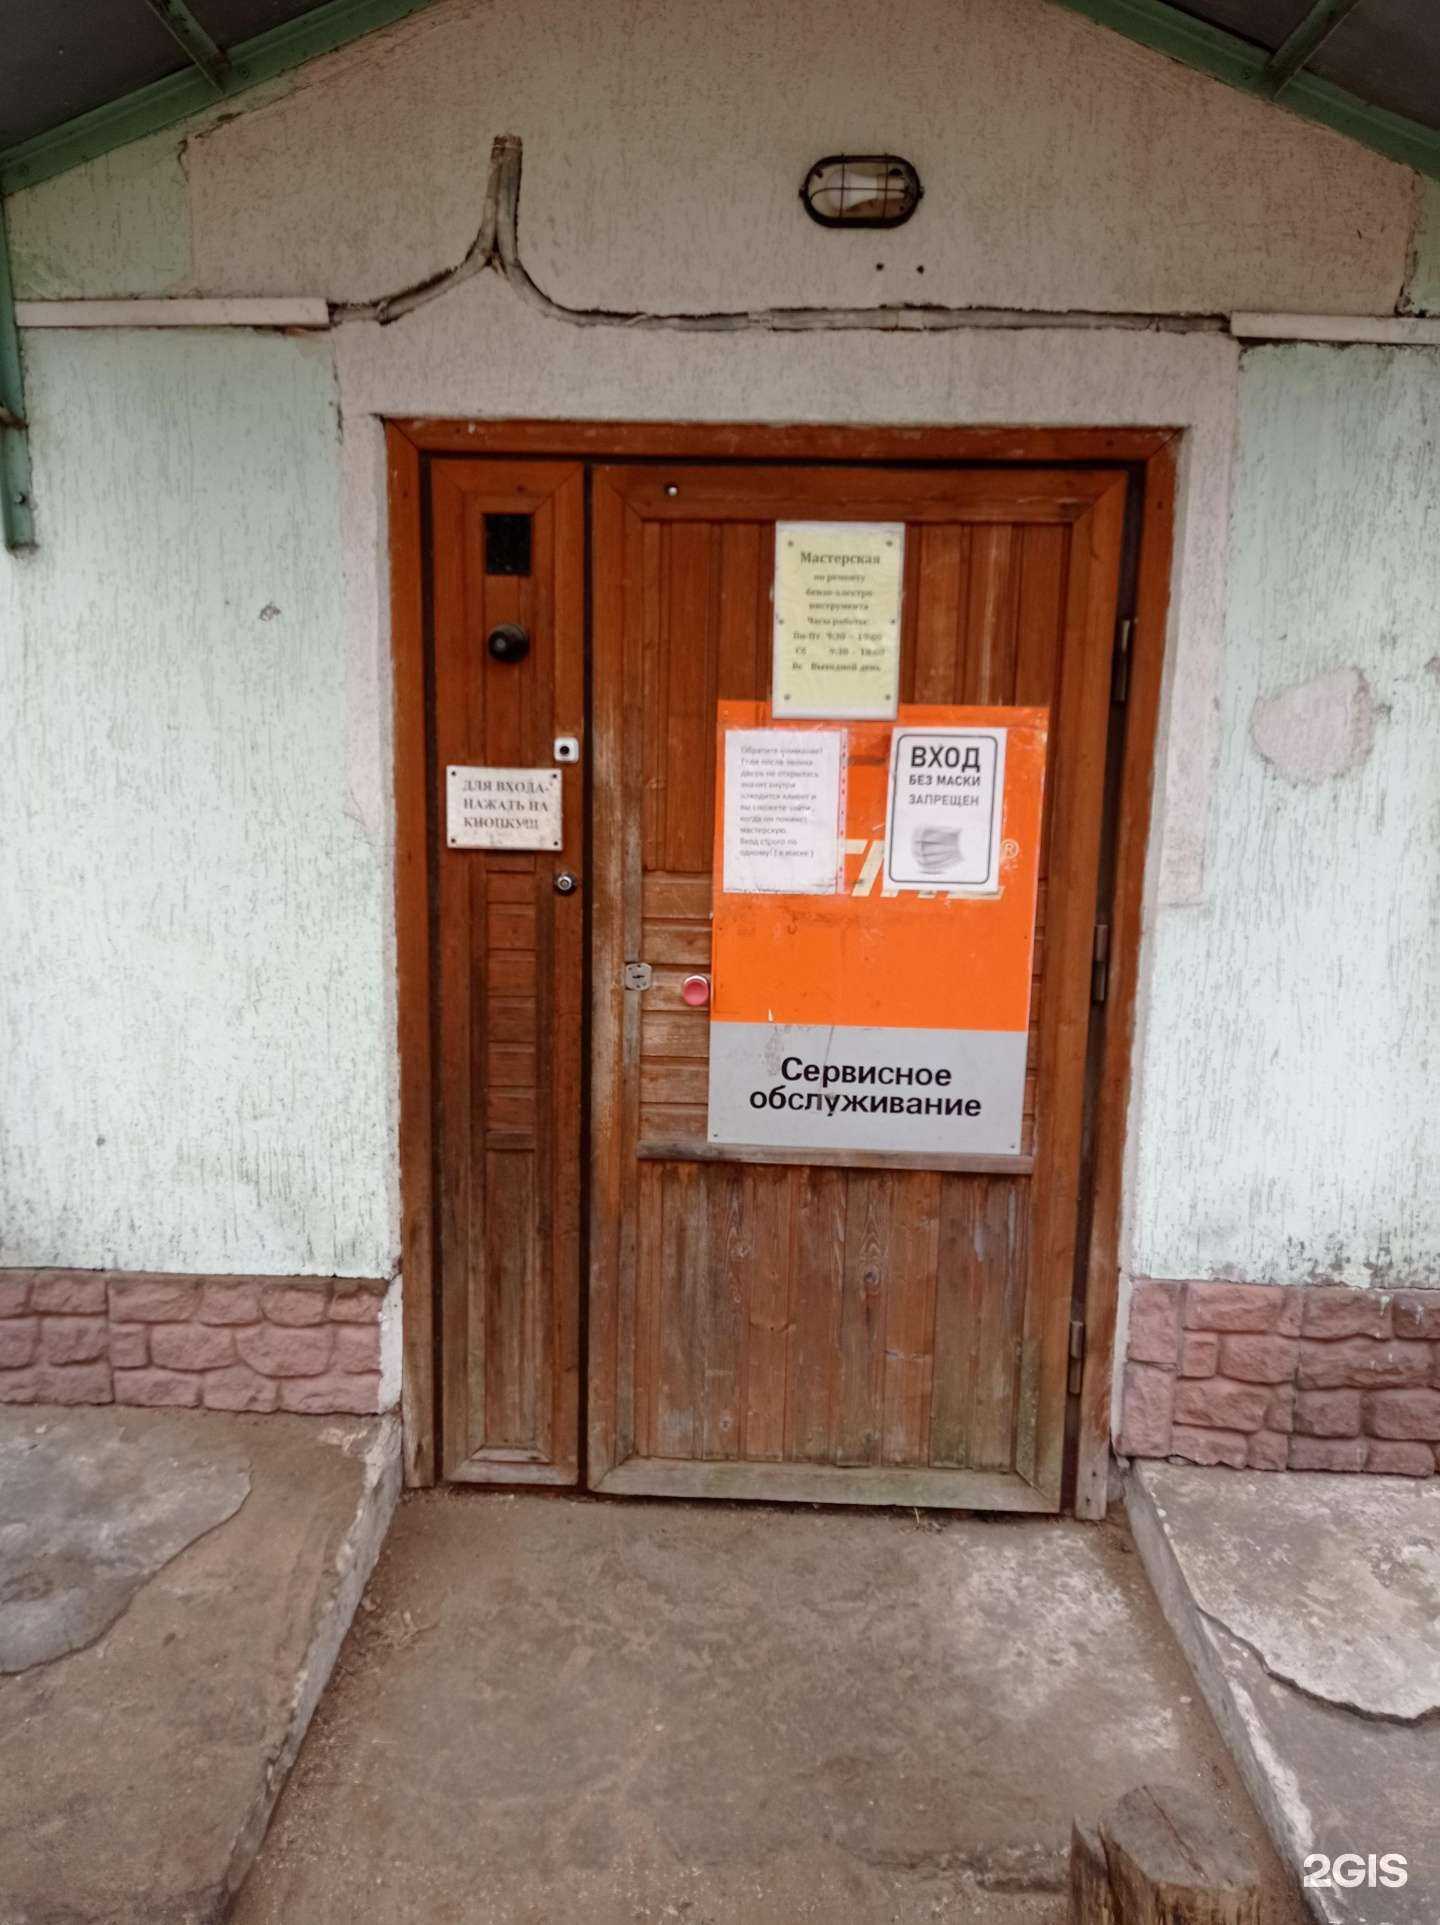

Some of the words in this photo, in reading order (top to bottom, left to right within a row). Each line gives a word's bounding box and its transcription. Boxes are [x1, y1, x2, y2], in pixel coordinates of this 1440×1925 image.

[800, 552, 880, 566] Мастерская
[807, 616, 831, 625] Часы
[911, 746, 981, 773] ВХОД
[462, 780, 492, 792] ДЛЯ
[909, 774, 933, 786] БЕЗ
[936, 775, 981, 787] МАСКИ
[463, 799, 525, 811] НАЖАТЬ
[529, 801, 549, 812] НА
[908, 794, 980, 807] ЗАПРЕЩЕН
[463, 817, 539, 830] КНОПКУ!!!
[781, 1057, 952, 1088] Сервисное
[750, 1085, 982, 1117] обслуживание
